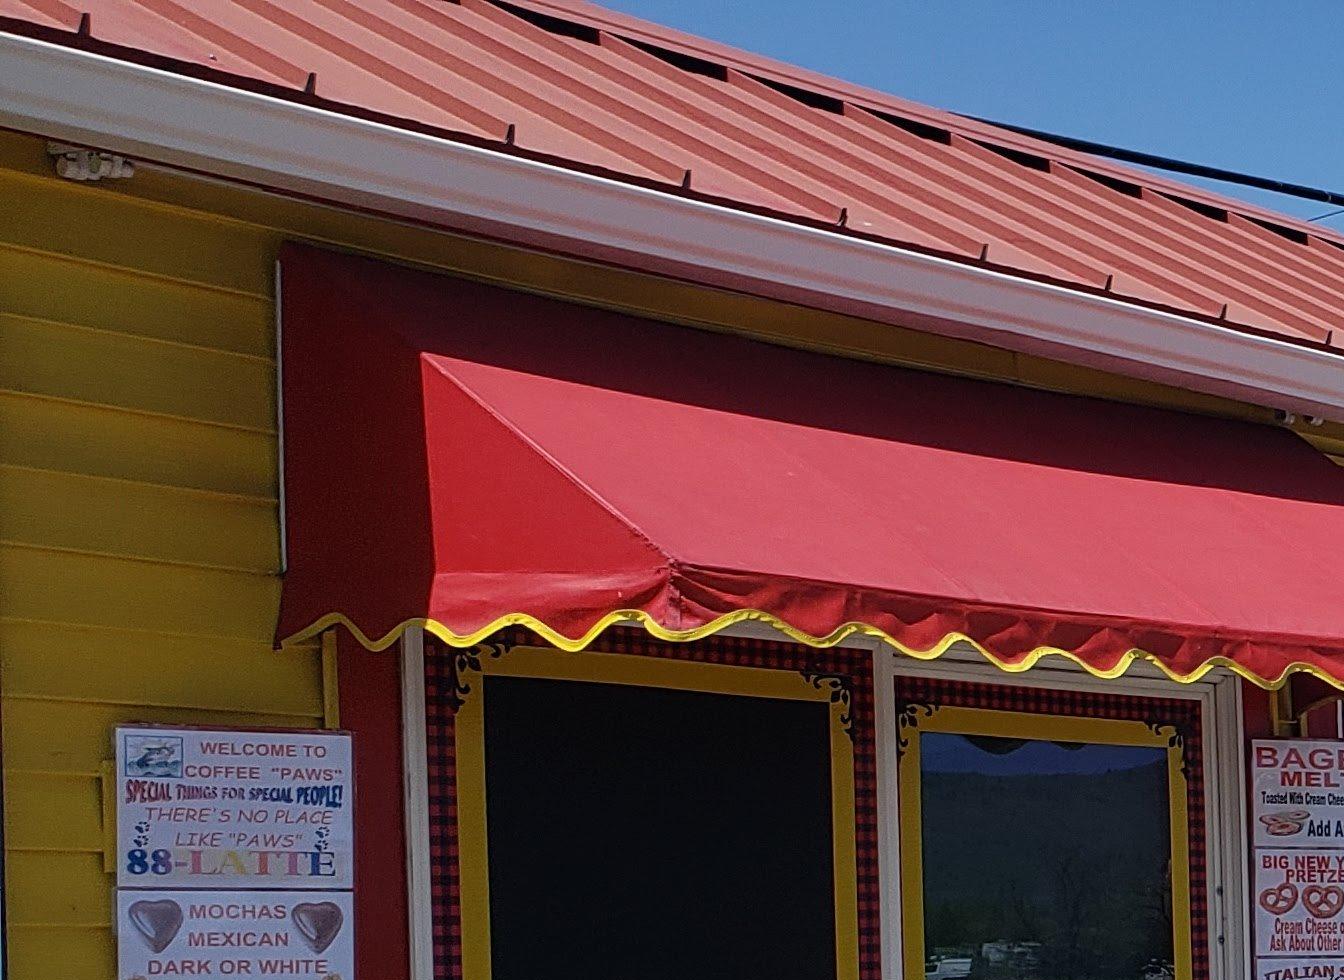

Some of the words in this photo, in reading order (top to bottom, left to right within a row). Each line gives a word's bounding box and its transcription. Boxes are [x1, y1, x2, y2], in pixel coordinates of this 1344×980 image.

[200, 742, 297, 757] WELCOME
[303, 745, 326, 758] TO
[185, 765, 260, 779] COFFEE
[271, 767, 342, 780] "PAWS"
[125, 779, 172, 804] SPECIAL
[175, 783, 217, 801] THINGS
[221, 786, 245, 800] FOR
[249, 787, 293, 803] SPECIAL
[296, 785, 342, 808] PEOPLE!
[1261, 791, 1287, 805] Toasted
[1289, 791, 1303, 804] With
[1305, 792, 1326, 806] Cream
[145, 807, 231, 823] THERE'S
[238, 809, 268, 823] NO
[275, 810, 333, 825] PLACE
[1307, 820, 1330, 838] Add
[175, 832, 223, 847] LIKE
[229, 833, 303, 848] "PAWS"
[126, 849, 336, 877] 88-LATTE
[1262, 855, 1289, 869] BIG
[1294, 856, 1330, 870] NEW
[189, 904, 287, 919] MOCHAS
[1275, 918, 1302, 934] Cream
[1306, 918, 1337, 934] Cheese
[188, 931, 289, 947] MEXICAN
[1270, 935, 1287, 951] Ask
[1289, 935, 1314, 951] About
[1318, 935, 1341, 951] Other
[147, 959, 212, 975] DARK
[219, 960, 251, 974] OR
[258, 959, 328, 974] WHITE
